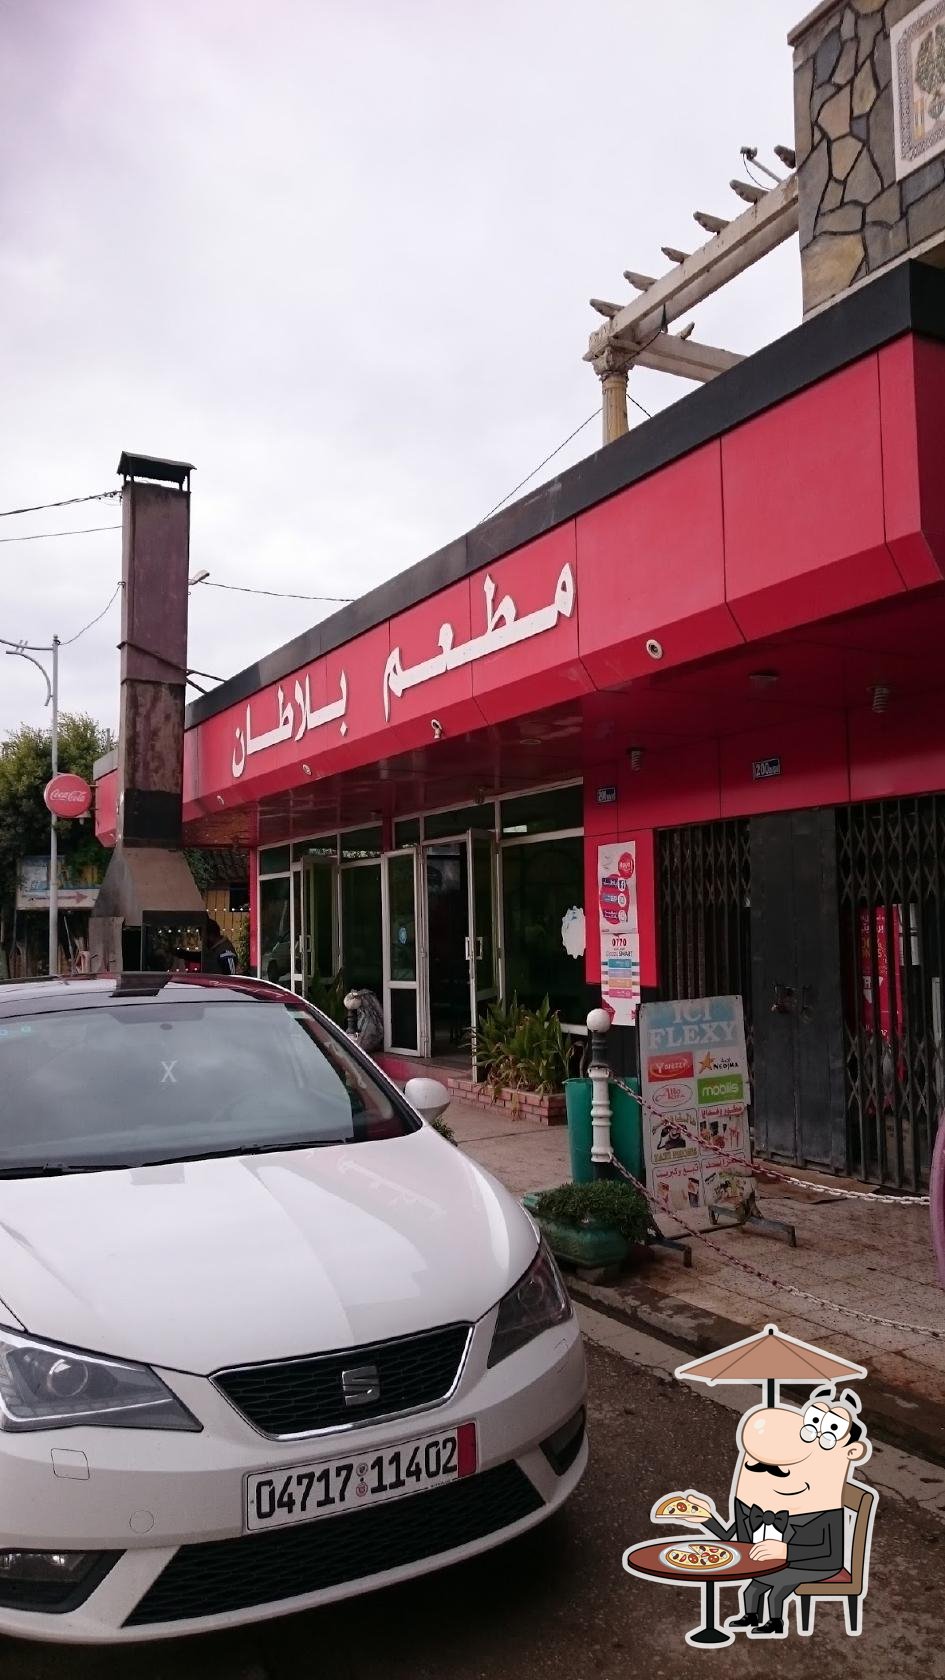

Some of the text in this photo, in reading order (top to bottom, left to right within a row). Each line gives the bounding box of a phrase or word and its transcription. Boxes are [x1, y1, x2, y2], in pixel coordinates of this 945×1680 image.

[383, 562, 575, 722] مطعم
[672, 1001, 712, 1024] ICI
[648, 1021, 735, 1049] FLEXY
[702, 1081, 739, 1097] mobilis
[255, 1436, 458, 1520] 04717 11402
